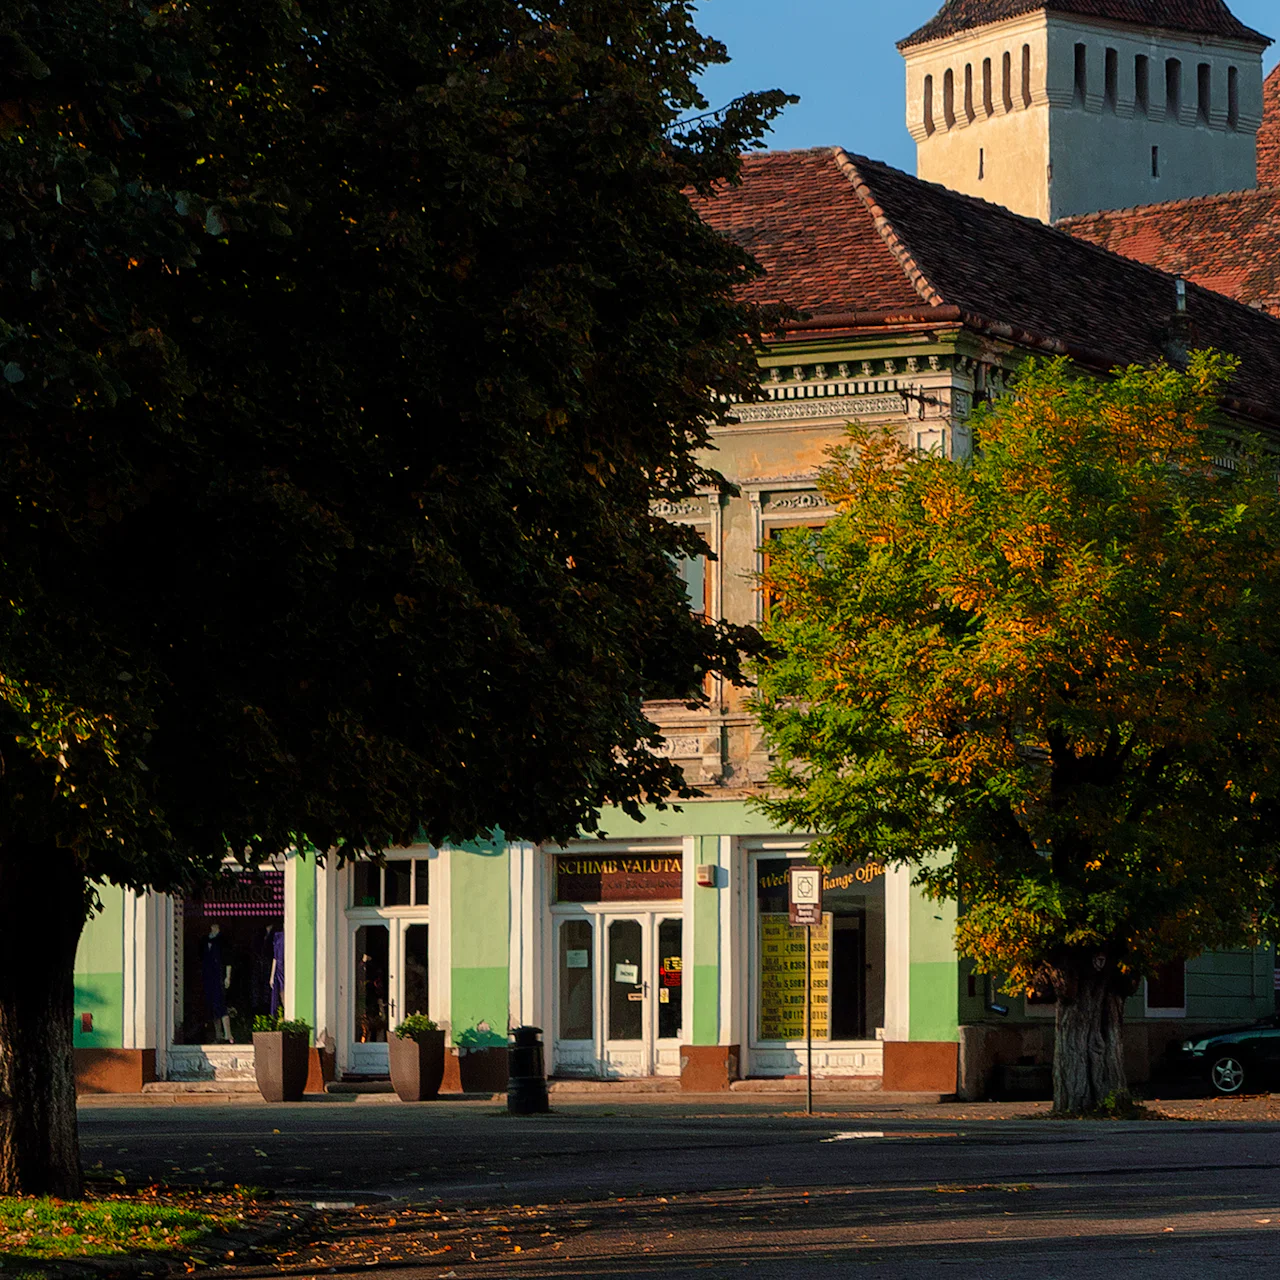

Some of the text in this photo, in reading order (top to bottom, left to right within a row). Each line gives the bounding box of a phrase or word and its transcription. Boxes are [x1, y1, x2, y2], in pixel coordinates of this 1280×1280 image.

[558, 857, 682, 875] SCHIMB VALUTA
[760, 870, 854, 891] Wech hange
